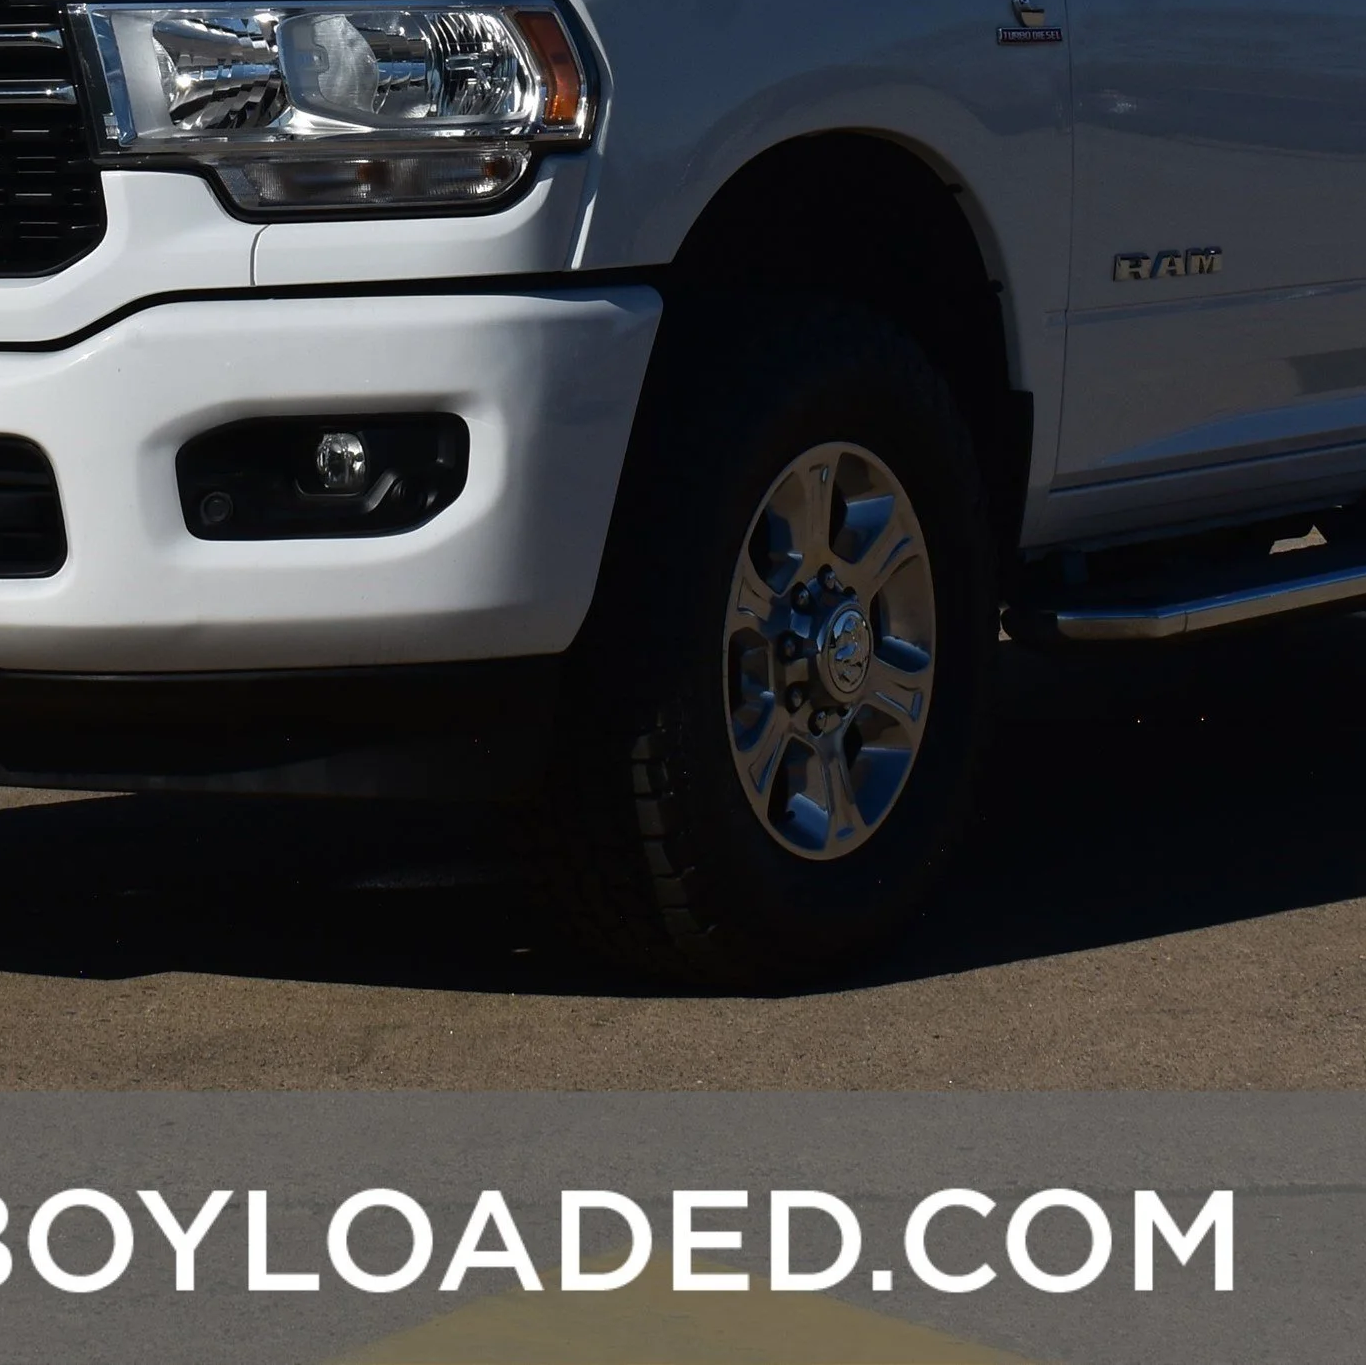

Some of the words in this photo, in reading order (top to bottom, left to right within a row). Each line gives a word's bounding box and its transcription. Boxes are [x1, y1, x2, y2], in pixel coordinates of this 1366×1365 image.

[1003, 30, 1031, 40] TURBO
[1032, 30, 1061, 40] DIESEL
[1113, 246, 1223, 281] RAM
